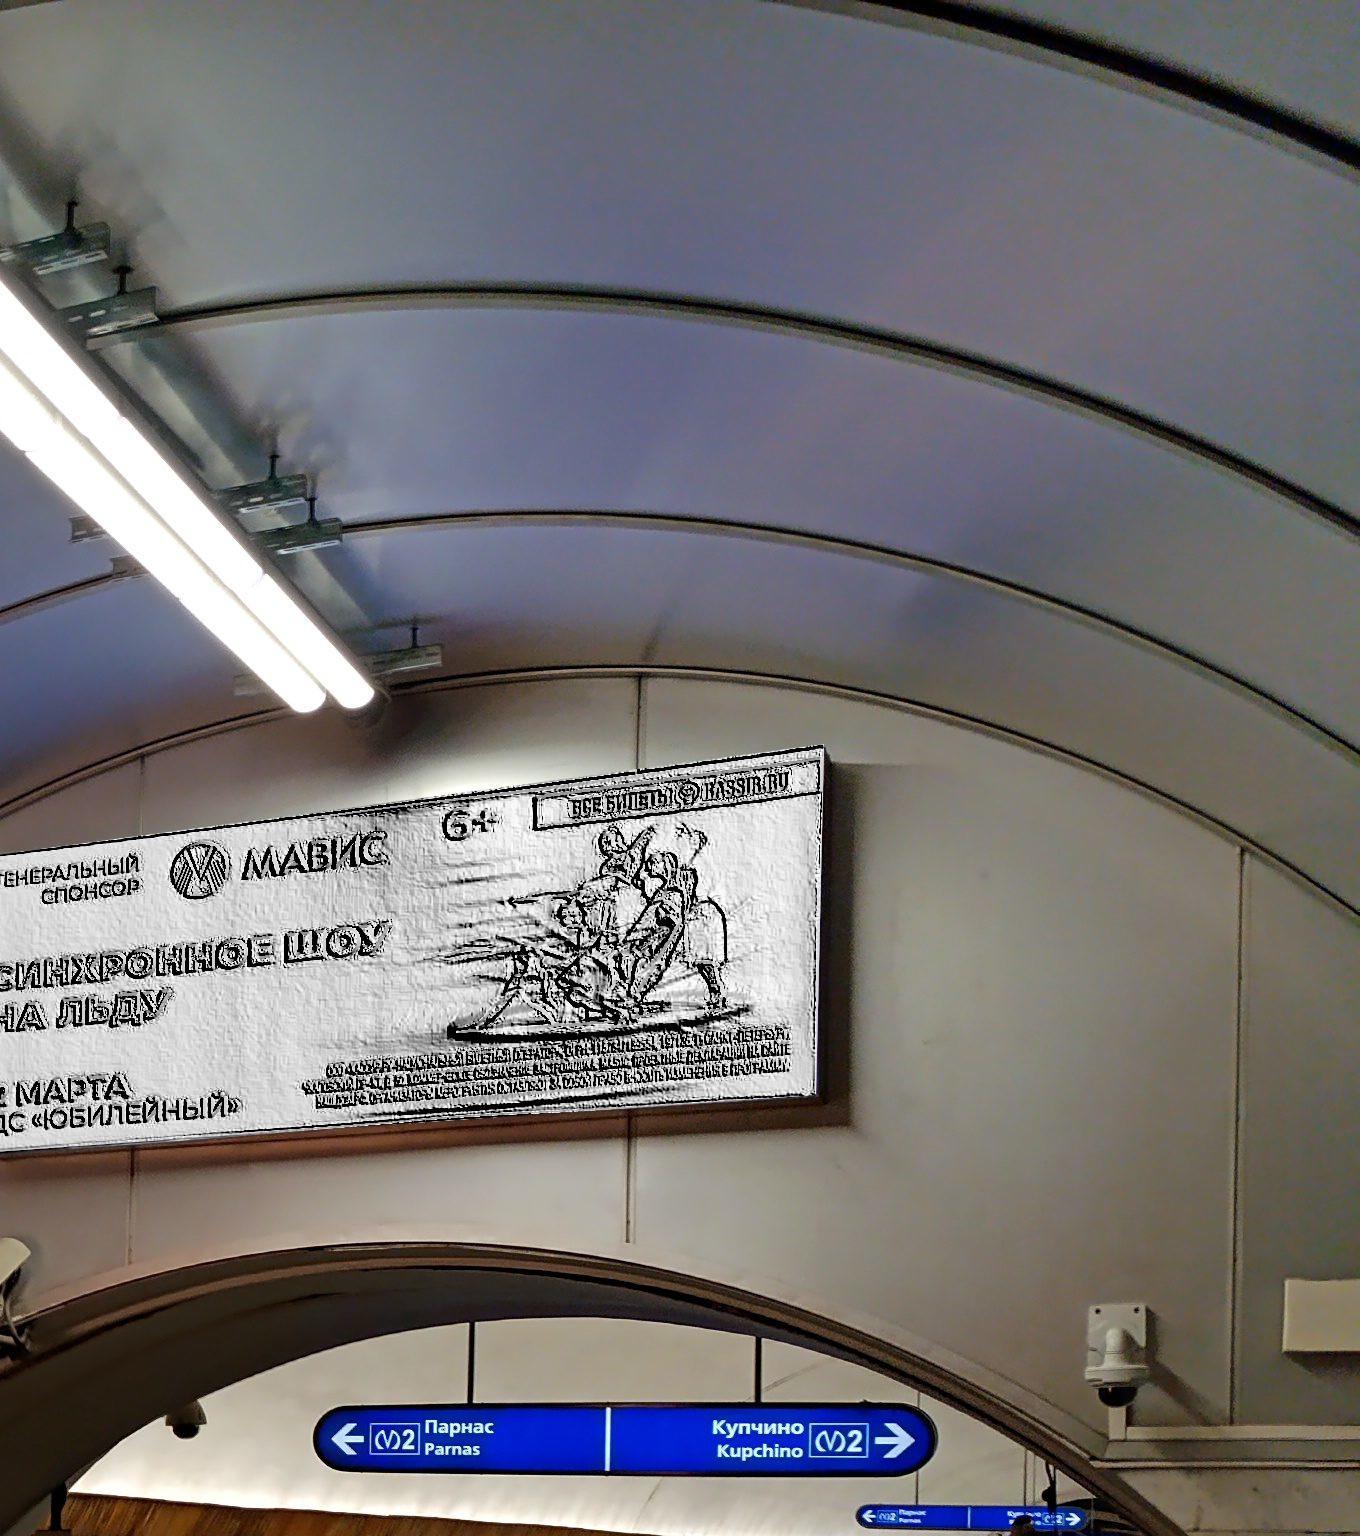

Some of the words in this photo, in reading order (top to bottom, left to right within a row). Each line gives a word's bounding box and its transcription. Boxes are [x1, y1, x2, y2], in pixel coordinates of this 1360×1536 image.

[442, 809, 498, 841] 6+
[241, 831, 389, 881] МАВИС
[41, 879, 142, 905] СПОНСОР
[282, 920, 393, 967] ШОУ
[55, 986, 176, 1029] ЛЬДУ
[15, 1071, 132, 1107] МАРТА
[32, 1090, 242, 1131] «ЮБИЛЕЙНЫЙ»
[425, 1419, 495, 1438] Парнас
[712, 1419, 805, 1439] Купчино
[425, 1442, 481, 1456] Parnas
[717, 1443, 804, 1461] Kupchino
